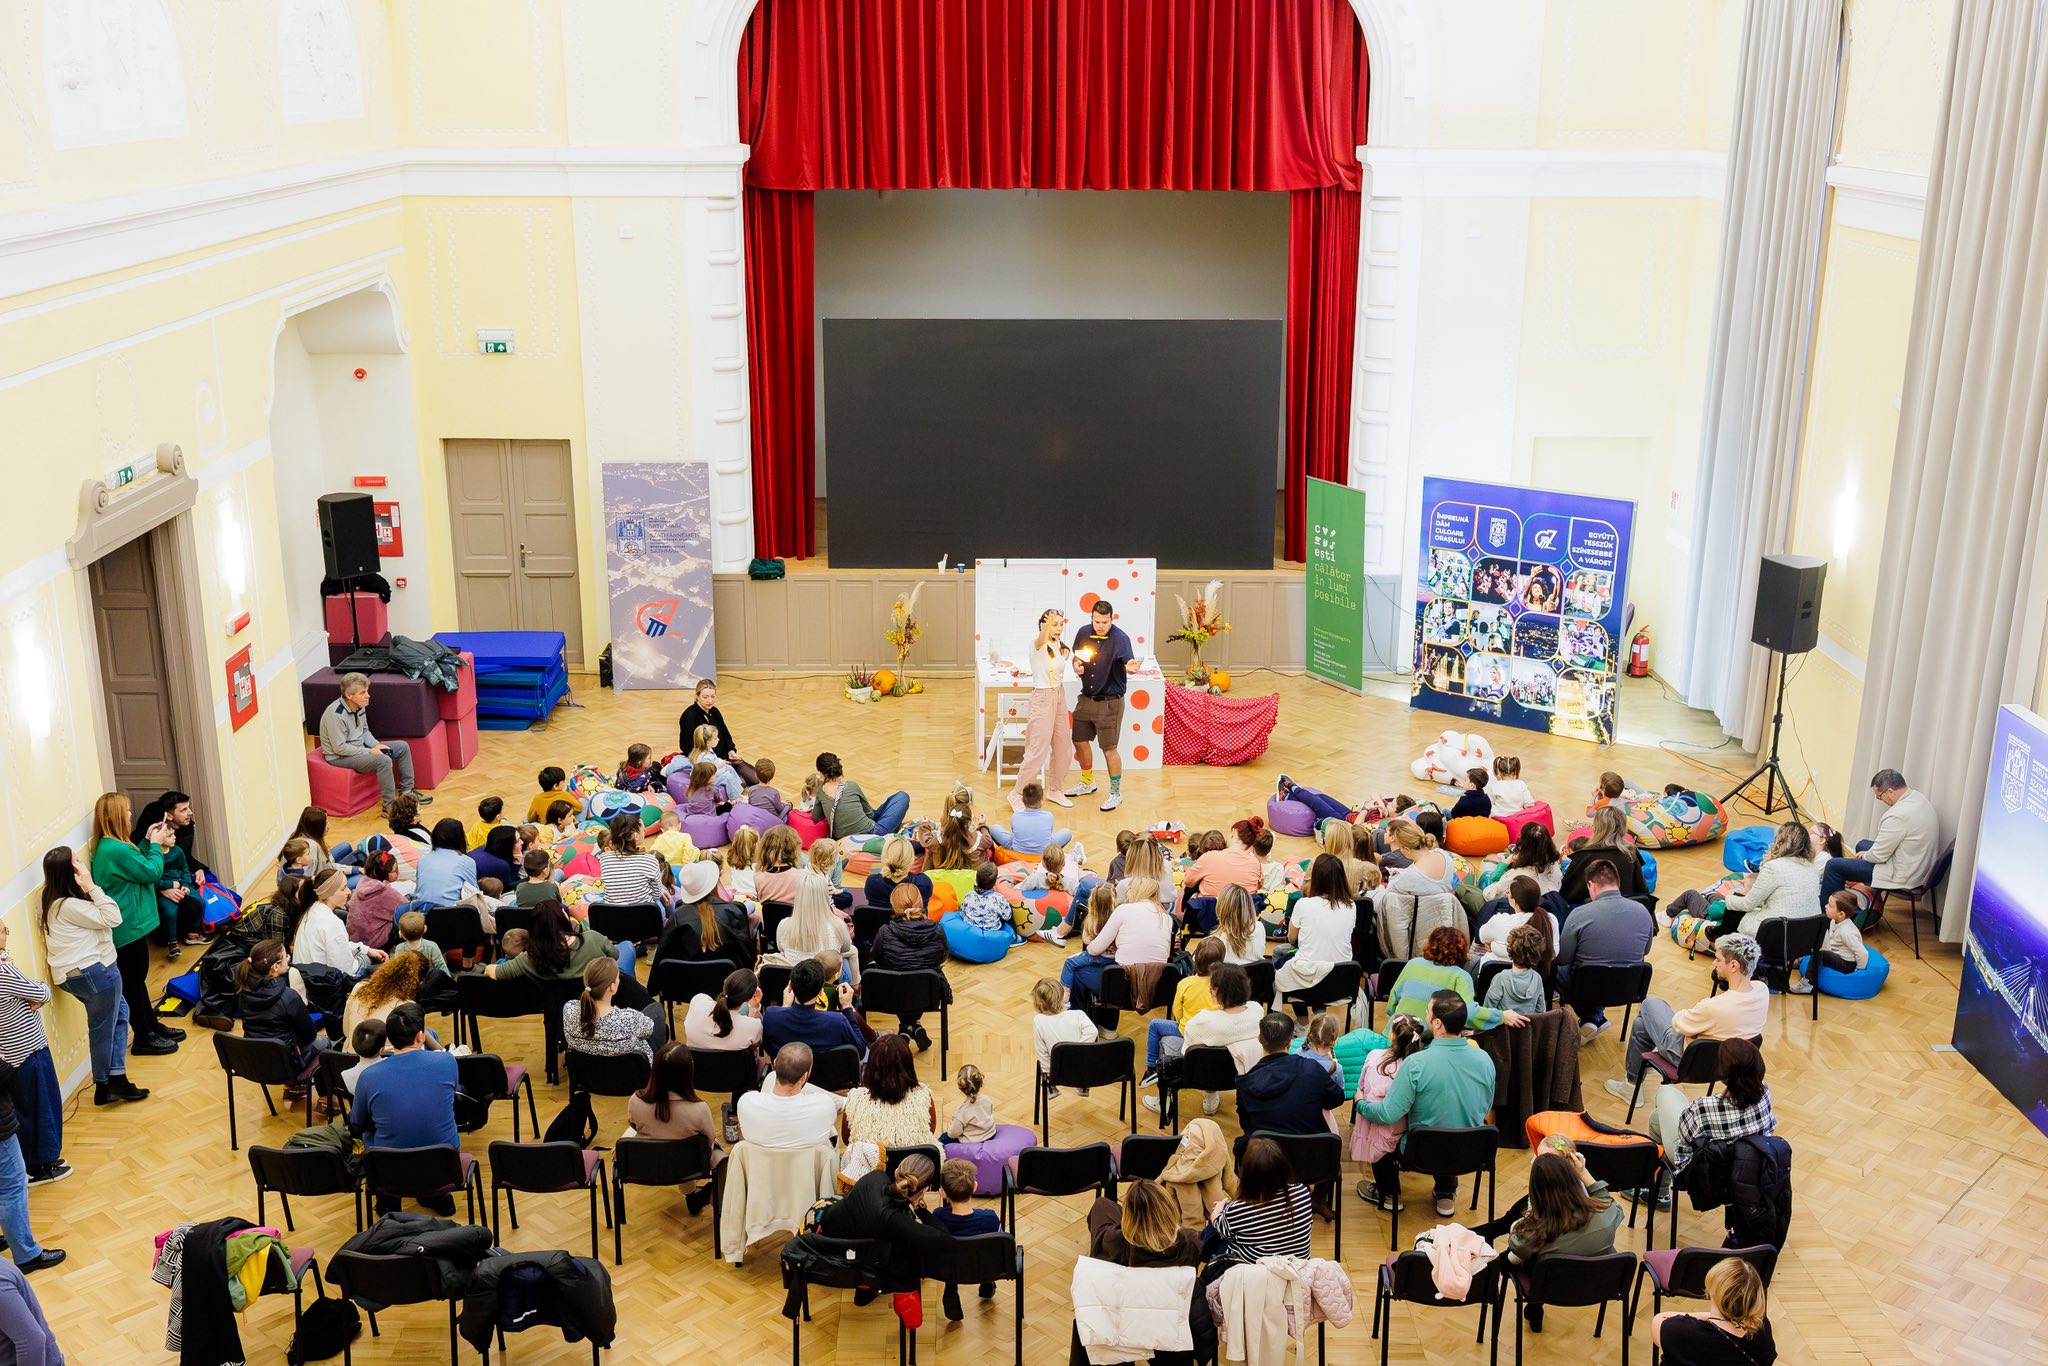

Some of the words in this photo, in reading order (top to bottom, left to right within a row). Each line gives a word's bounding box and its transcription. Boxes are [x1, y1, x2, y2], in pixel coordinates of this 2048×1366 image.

[1435, 528, 1464, 537] CULOARE
[1589, 532, 1615, 540] EGYÜTT
[1584, 540, 1614, 549] TESSZÜK
[1585, 557, 1612, 566] VÁROST
[1328, 578, 1348, 595] lumi
[1314, 589, 1357, 610] posibile
